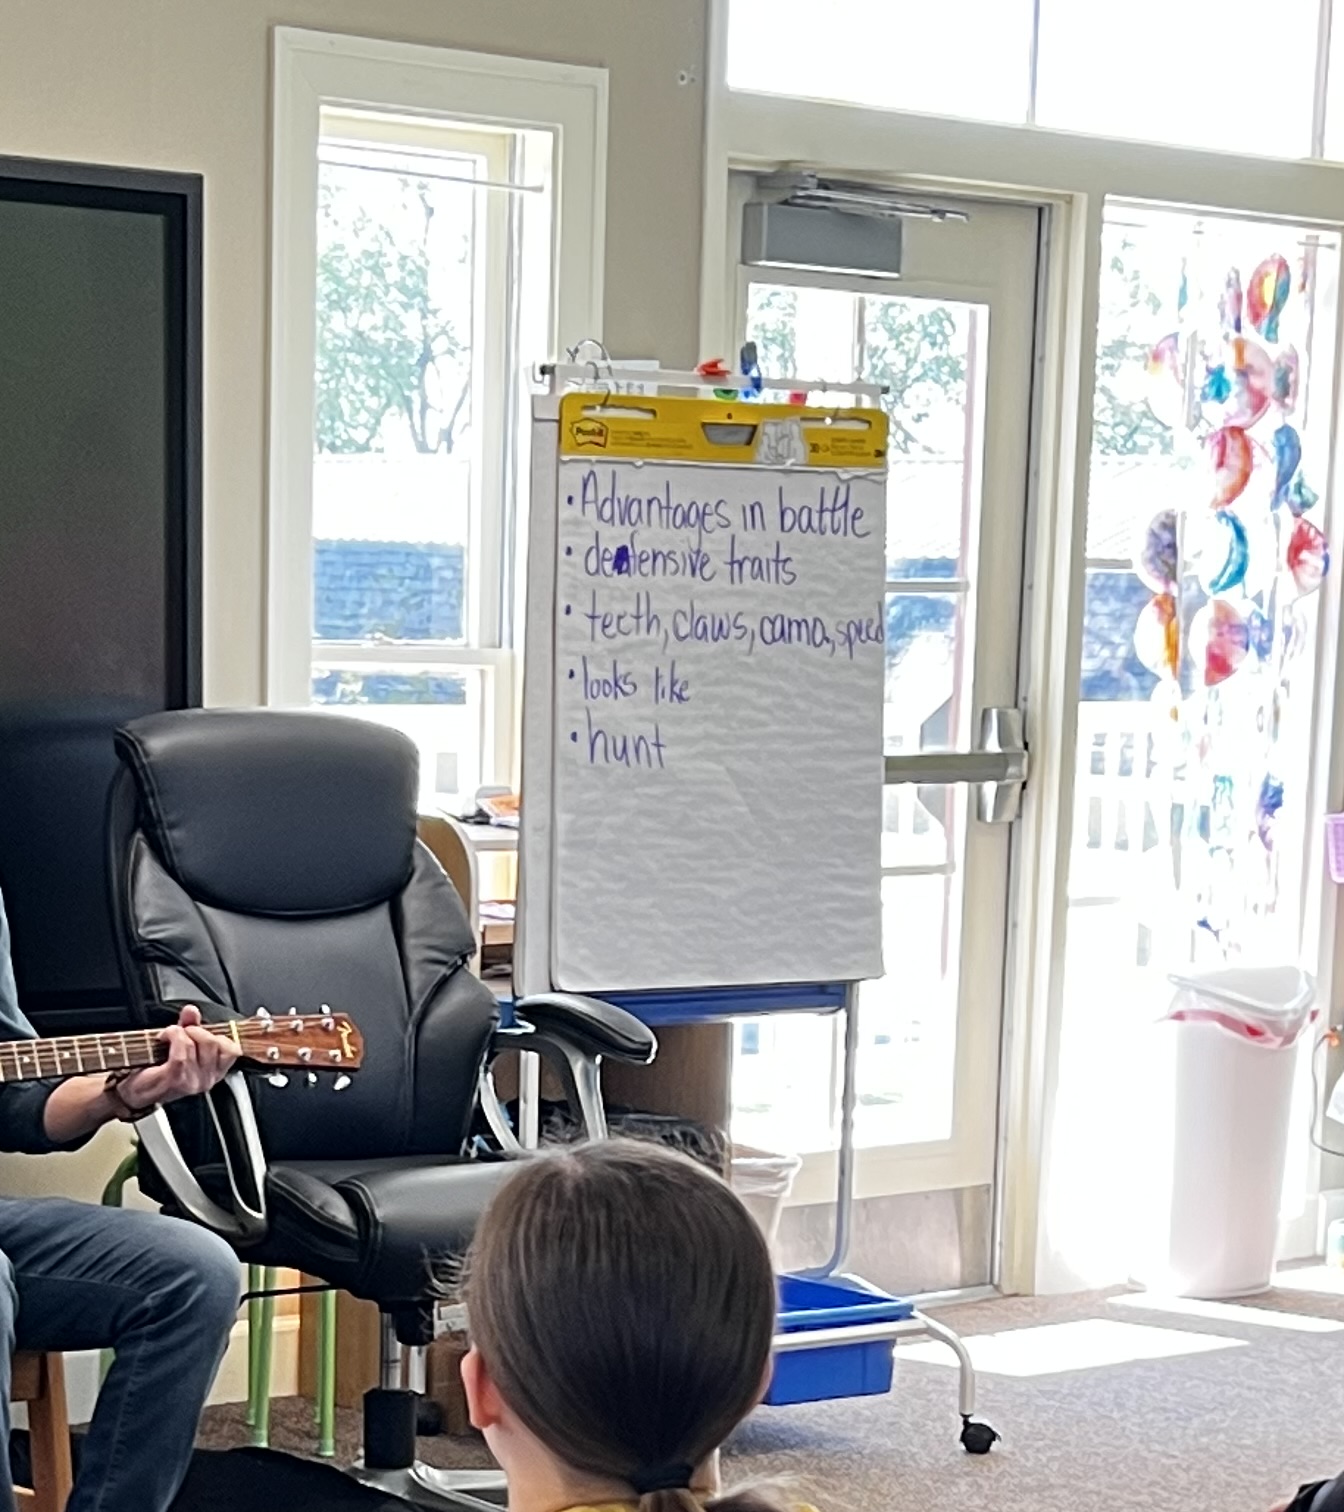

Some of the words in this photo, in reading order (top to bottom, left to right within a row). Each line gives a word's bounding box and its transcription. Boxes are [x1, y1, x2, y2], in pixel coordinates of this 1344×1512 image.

[582, 469, 732, 550] Advantages
[742, 499, 766, 533] in
[778, 483, 872, 539] battle
[723, 533, 798, 586] traits
[582, 654, 638, 701] looks
[655, 659, 691, 705] like
[585, 705, 667, 769] hunt
